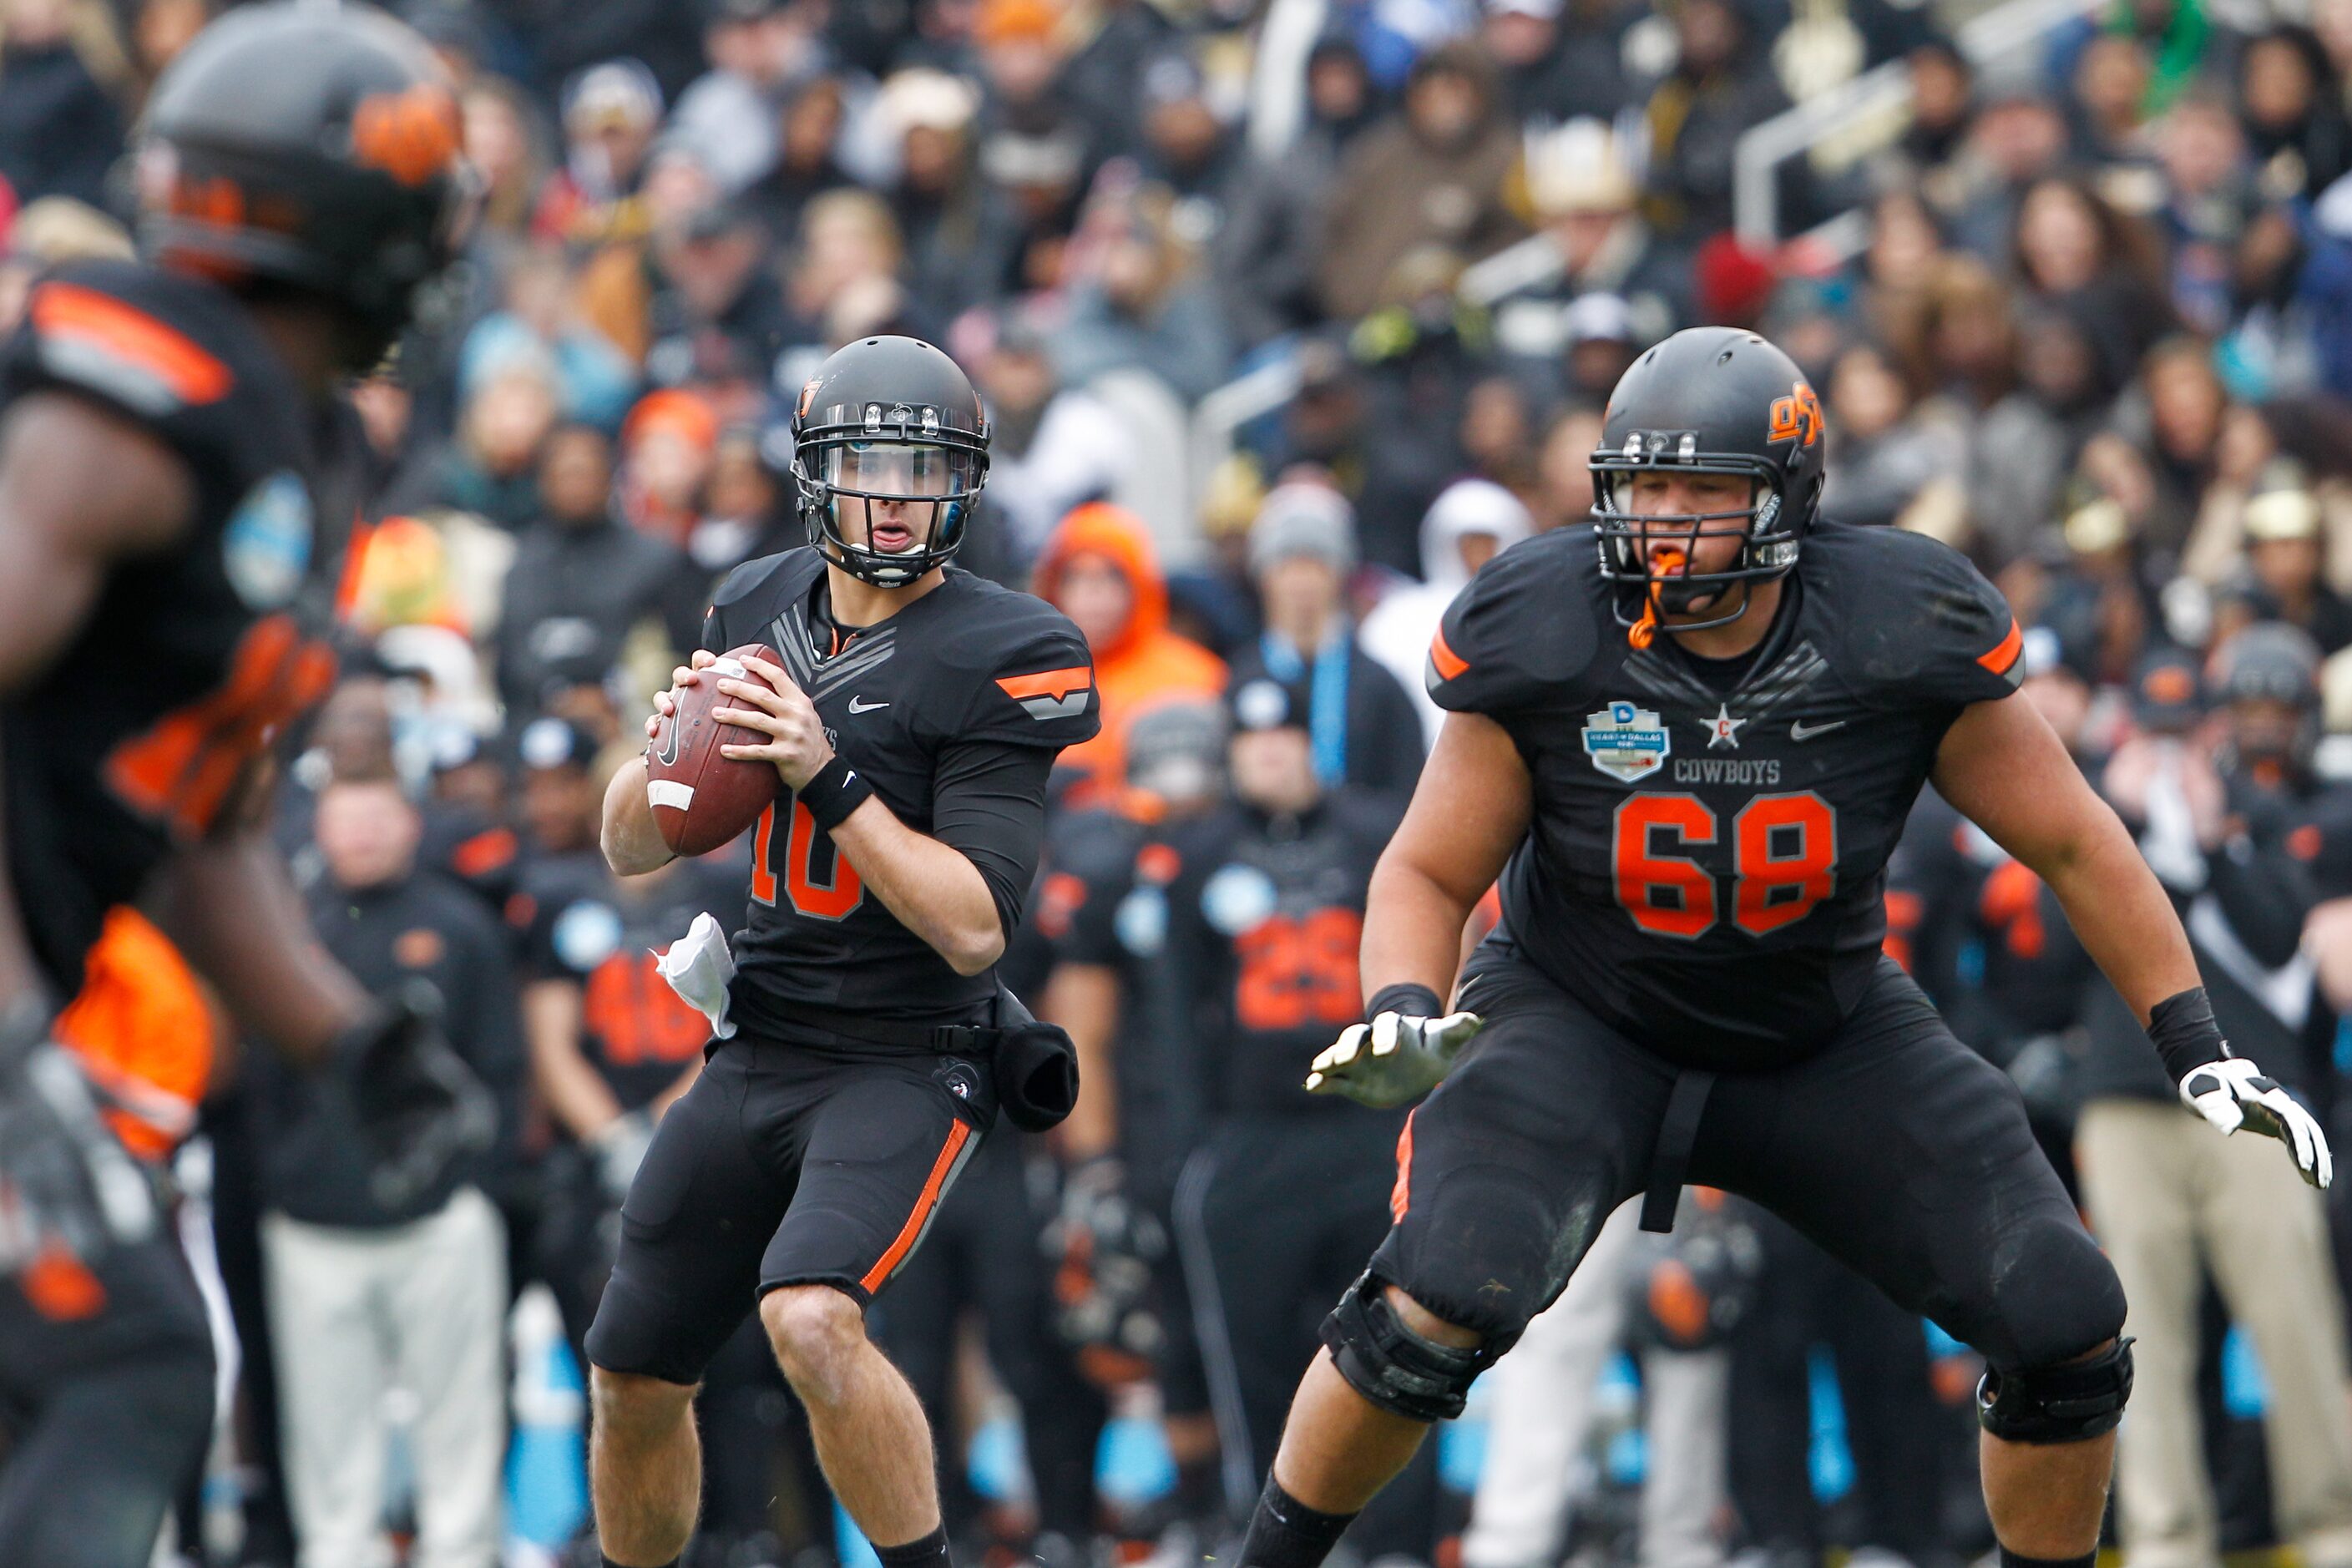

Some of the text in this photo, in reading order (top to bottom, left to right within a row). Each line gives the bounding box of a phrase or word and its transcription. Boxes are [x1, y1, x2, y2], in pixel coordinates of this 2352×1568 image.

[1627, 733, 1662, 741] DALLAS
[1717, 721, 1729, 736] C
[1674, 758, 1781, 784] COWBOYS
[751, 792, 866, 923] 10
[1611, 789, 1839, 940] 68
